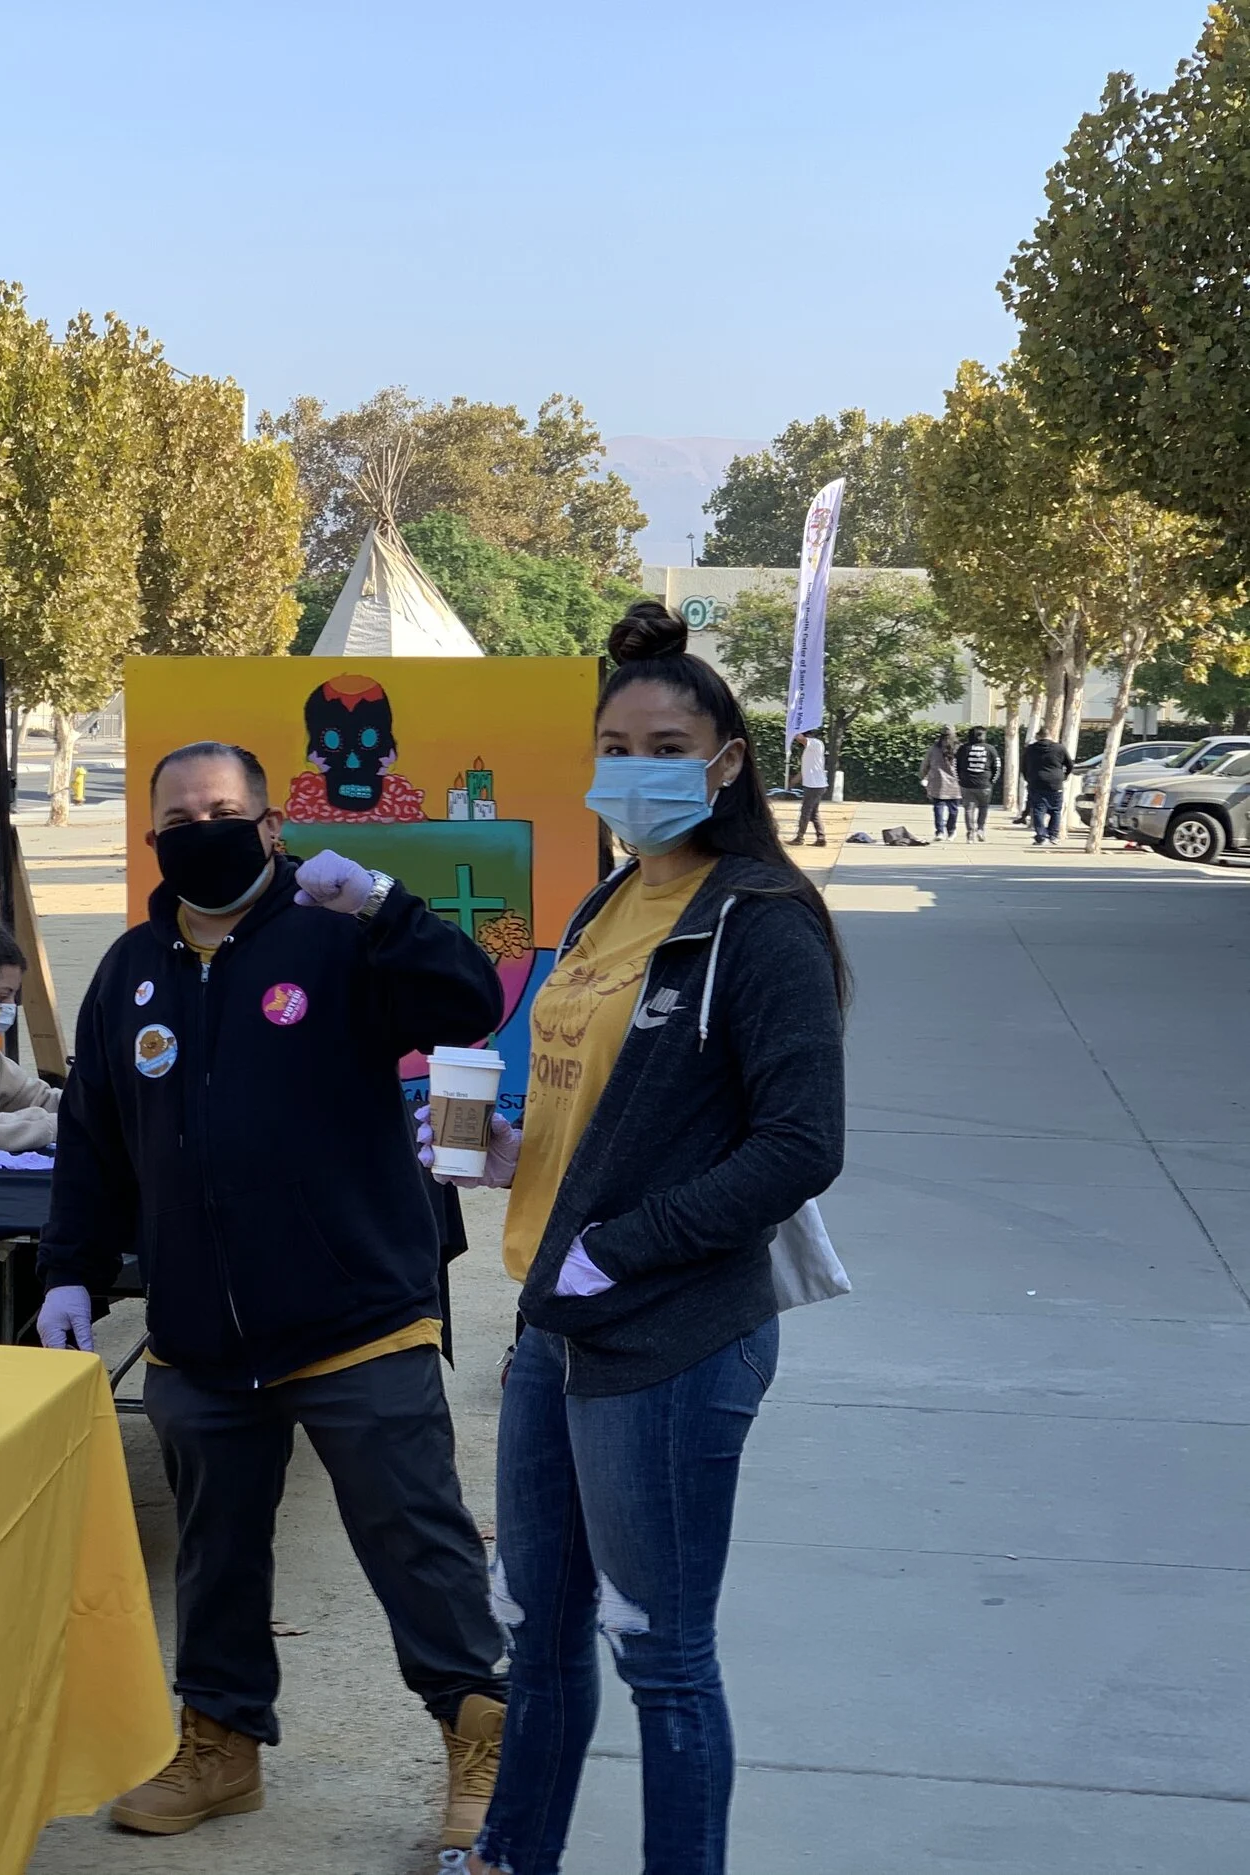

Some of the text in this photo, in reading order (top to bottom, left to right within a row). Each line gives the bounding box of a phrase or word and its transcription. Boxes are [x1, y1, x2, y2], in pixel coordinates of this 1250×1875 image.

[803, 607, 811, 632] Health
[800, 633, 809, 657] Center
[798, 670, 806, 691] Santa
[531, 1052, 582, 1091] POWER
